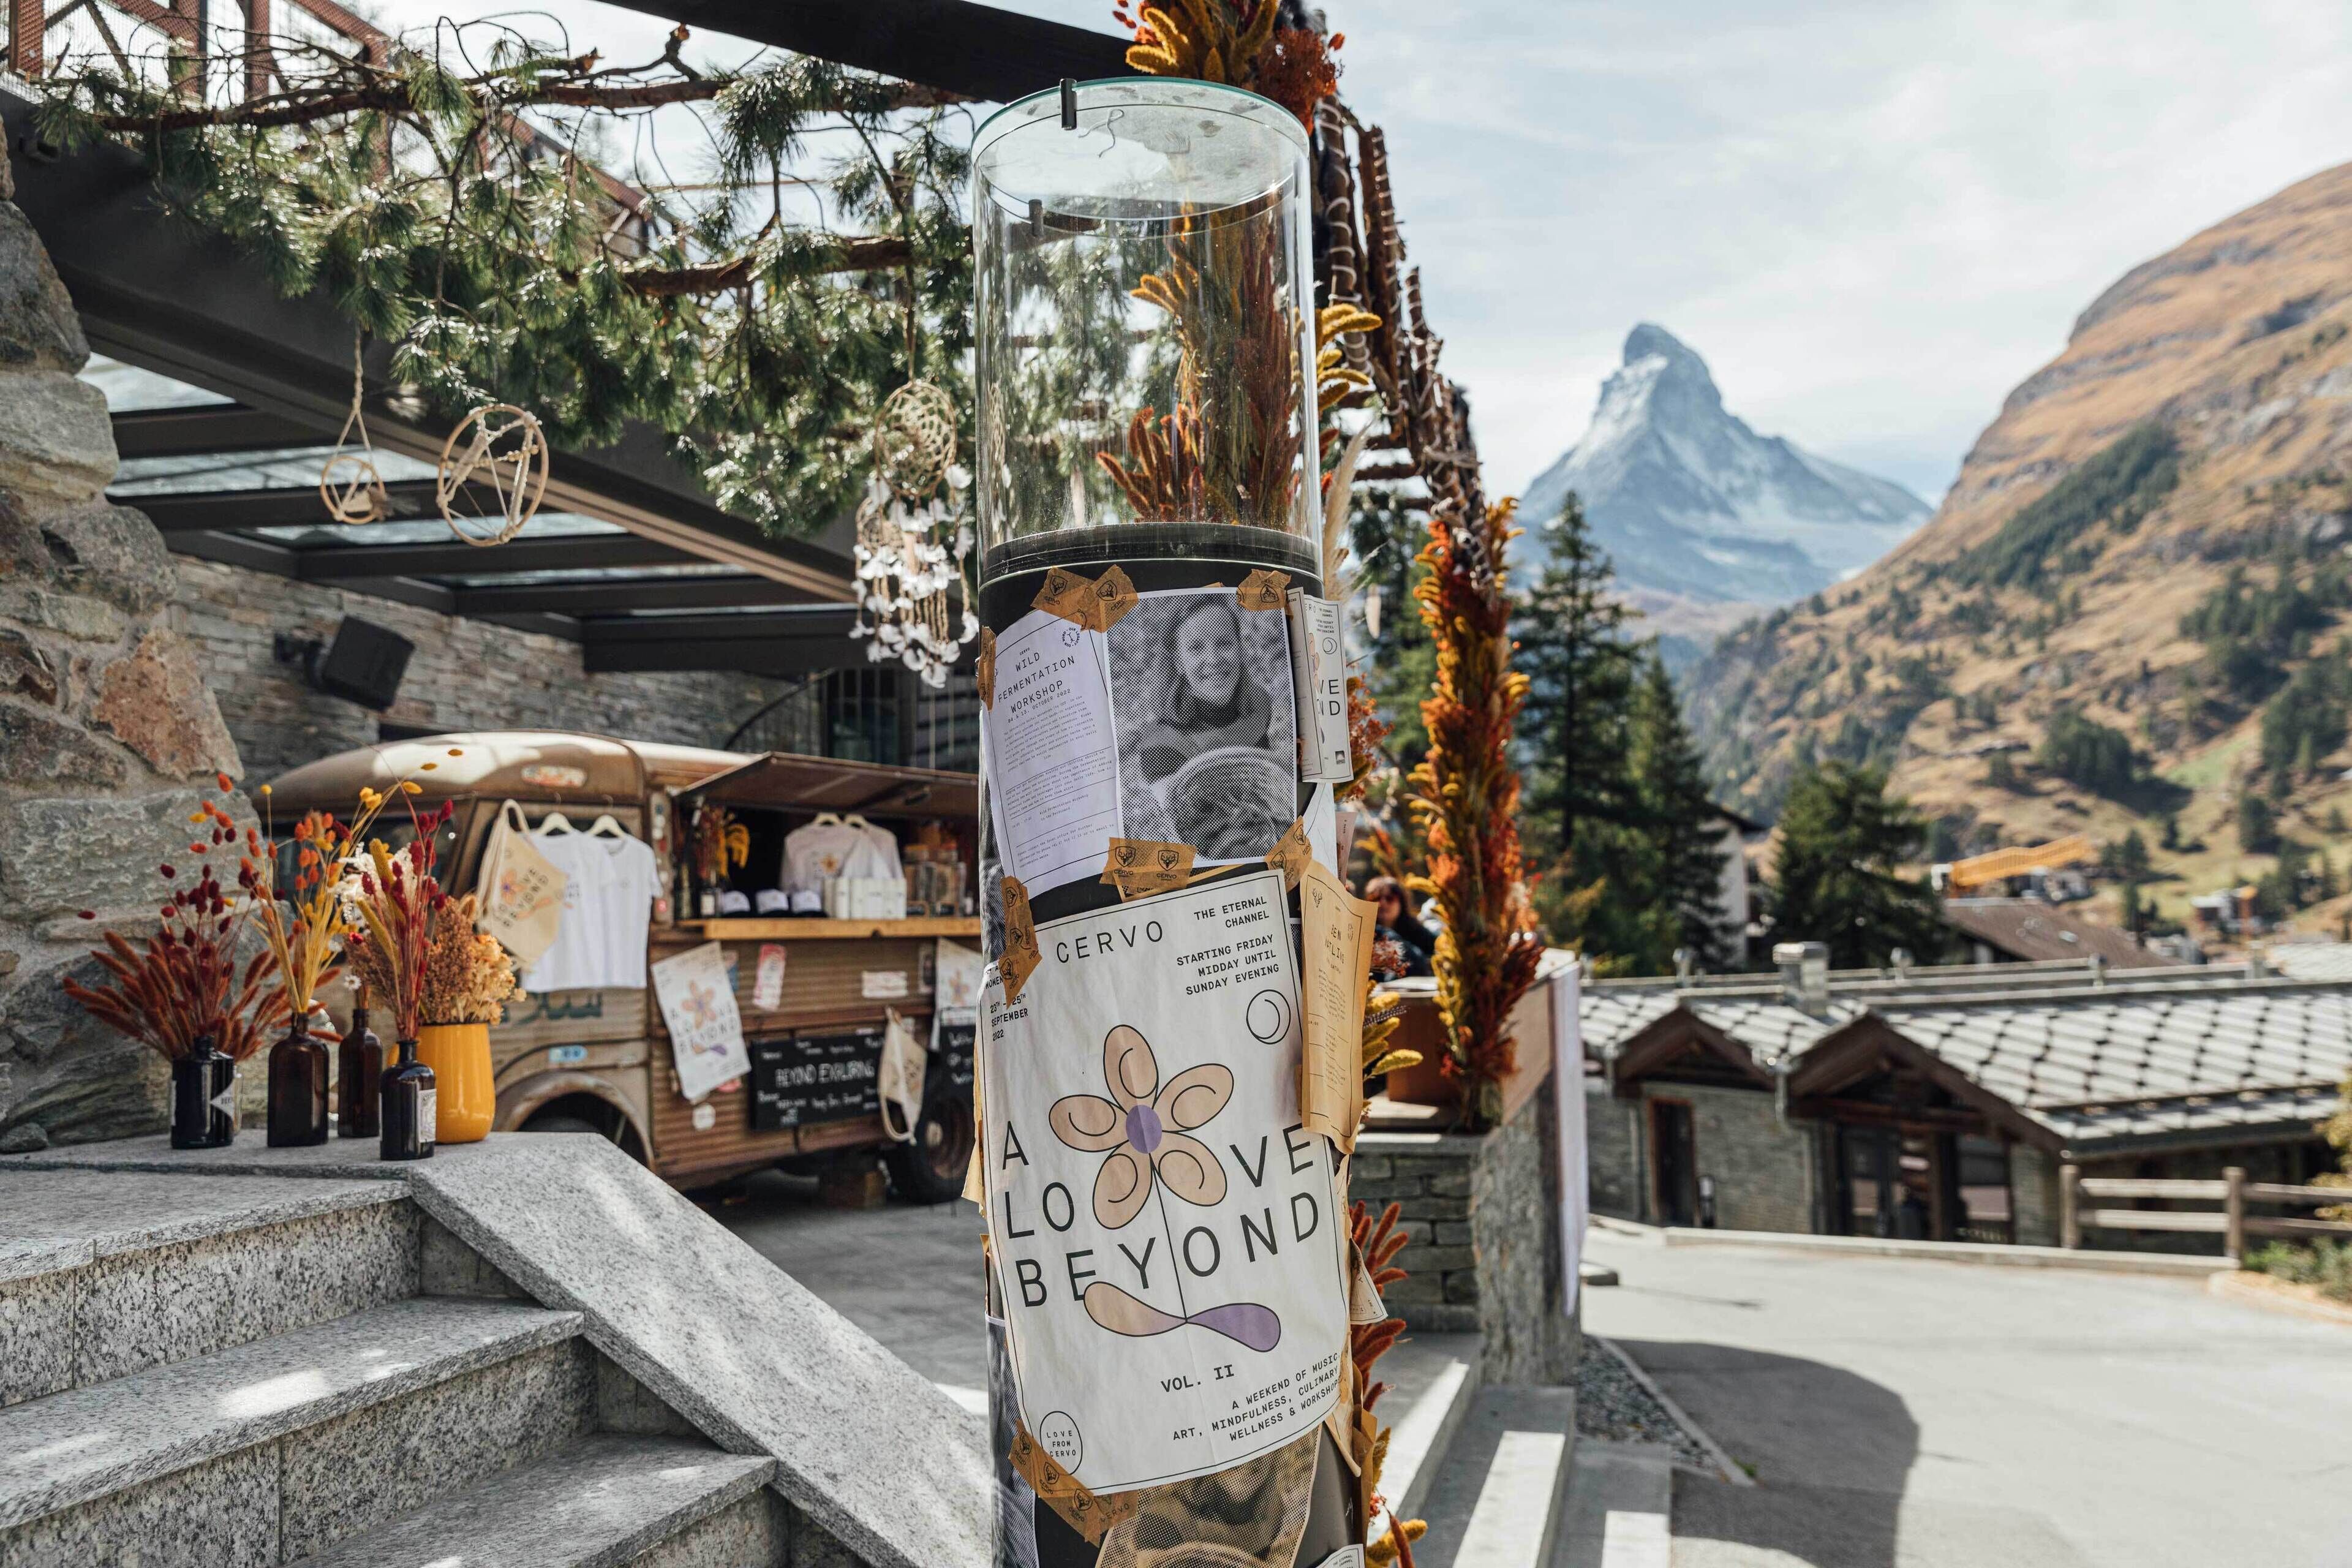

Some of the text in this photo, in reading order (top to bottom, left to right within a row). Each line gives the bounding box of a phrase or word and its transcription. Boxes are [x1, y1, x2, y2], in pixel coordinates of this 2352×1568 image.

[1016, 652, 1040, 672] WILD
[1019, 647, 1030, 656] CERVO
[998, 655, 1075, 703] FERMENTATION
[1011, 680, 1063, 714] WORKSHOP
[1032, 696, 1054, 710] OCTOBER
[1057, 688, 1071, 698] 2022
[1194, 896, 1267, 920] THE ETERNAL
[1225, 910, 1269, 928] CHANNEL
[1055, 921, 1163, 963] CERVO
[1177, 934, 1273, 966] STARTING FRIDAY
[1186, 963, 1279, 995] SUNDAY EVENING
[1198, 949, 1276, 977] MIDDAY UNTIL
[991, 1008, 1028, 1028] SEPTEMBER
[992, 1030, 1004, 1041] 2022
[1003, 1121, 1030, 1170] A
[1015, 1191, 1319, 1307] BEYOND
[1161, 1364, 1235, 1393] VOL. II
[1232, 1400, 1239, 1410] A
[1246, 1378, 1290, 1405] WEEKEND
[1295, 1370, 1307, 1382] OF
[1173, 1365, 1338, 1441] ART, MINDFULNESS, CULINARY
[1229, 1412, 1283, 1441] WELLNESS
[1289, 1407, 1296, 1417] &
